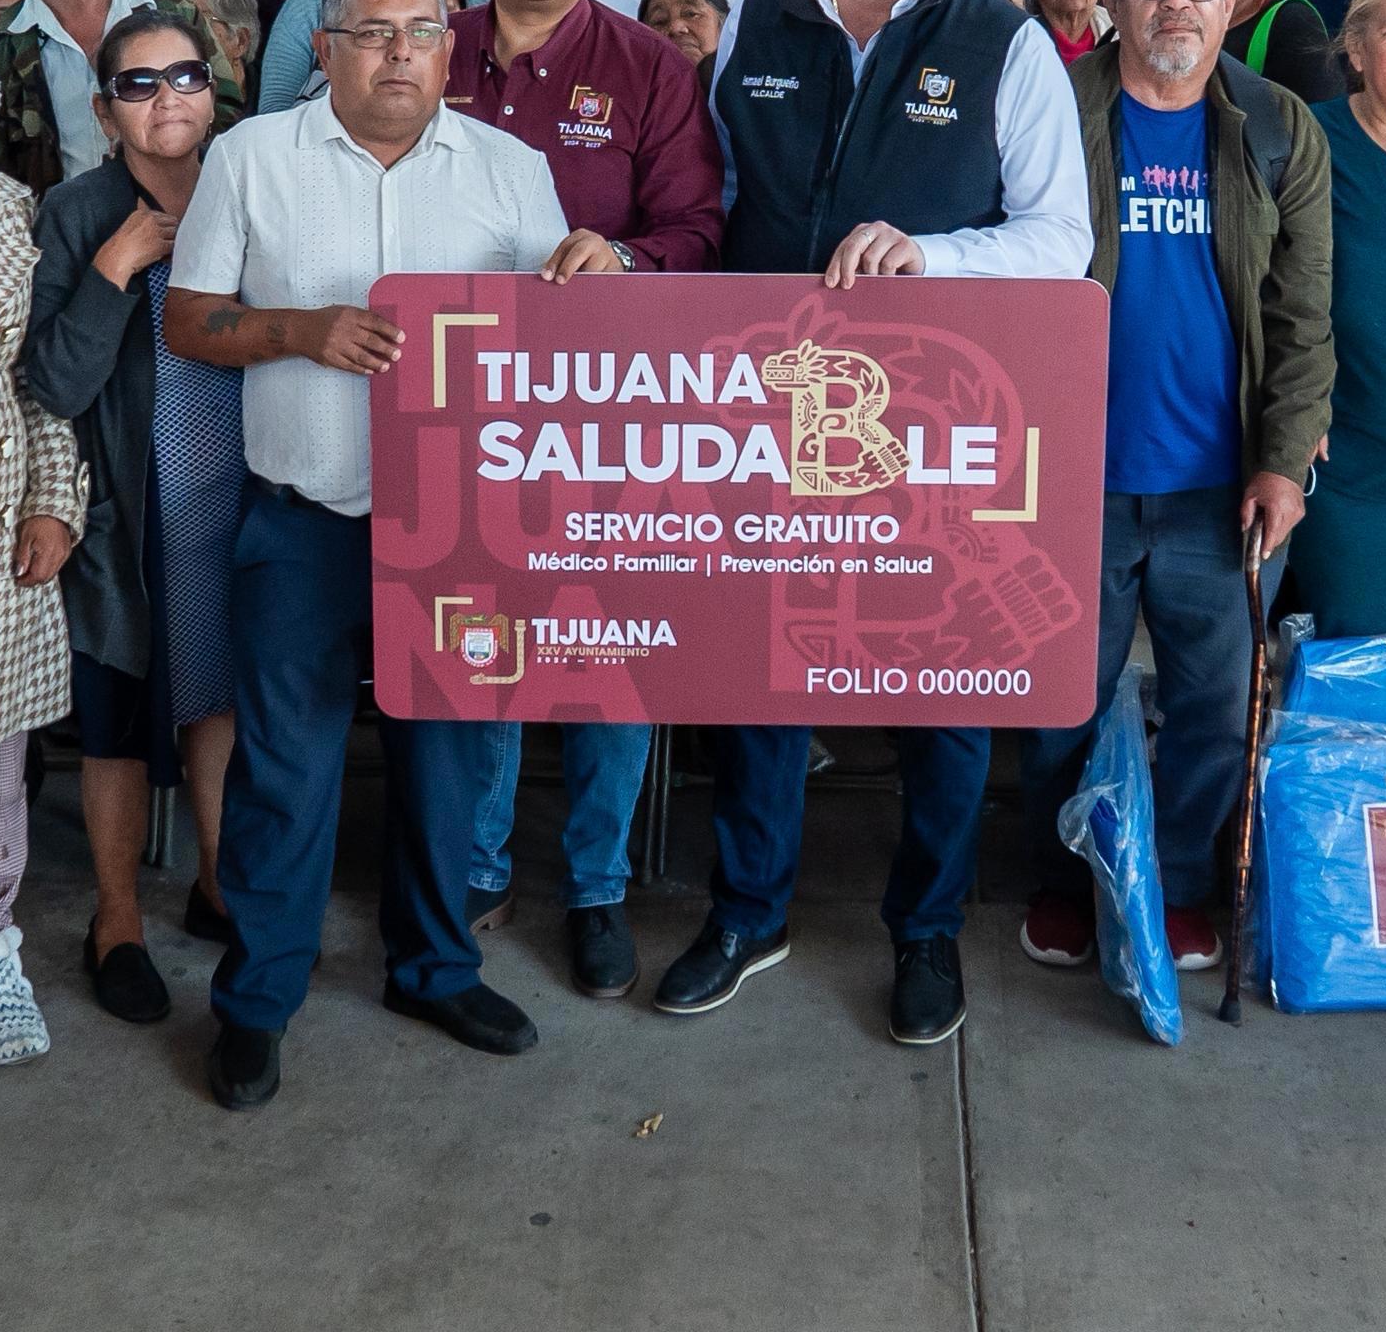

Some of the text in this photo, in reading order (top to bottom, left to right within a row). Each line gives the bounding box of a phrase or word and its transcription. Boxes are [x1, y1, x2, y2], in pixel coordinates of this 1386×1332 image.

[742, 75, 800, 90] Ismael Burgueño
[751, 90, 785, 99] ALCALDE
[905, 102, 958, 120] TIJUANA
[558, 122, 612, 140] TIJUANA
[478, 352, 768, 404] TIJUANA
[477, 340, 997, 496] SALUDABLE
[566, 513, 900, 544] SERVICIO GRATUITO
[529, 551, 608, 571] Médico
[615, 554, 698, 572] Familiar
[722, 554, 835, 573] Prevención
[842, 559, 868, 573] en
[875, 556, 933, 574] Salud
[532, 619, 677, 646] TIJUANA
[537, 646, 650, 657] XXV AYUNTAMIENTO
[808, 668, 1031, 695] FOLIO 000000
